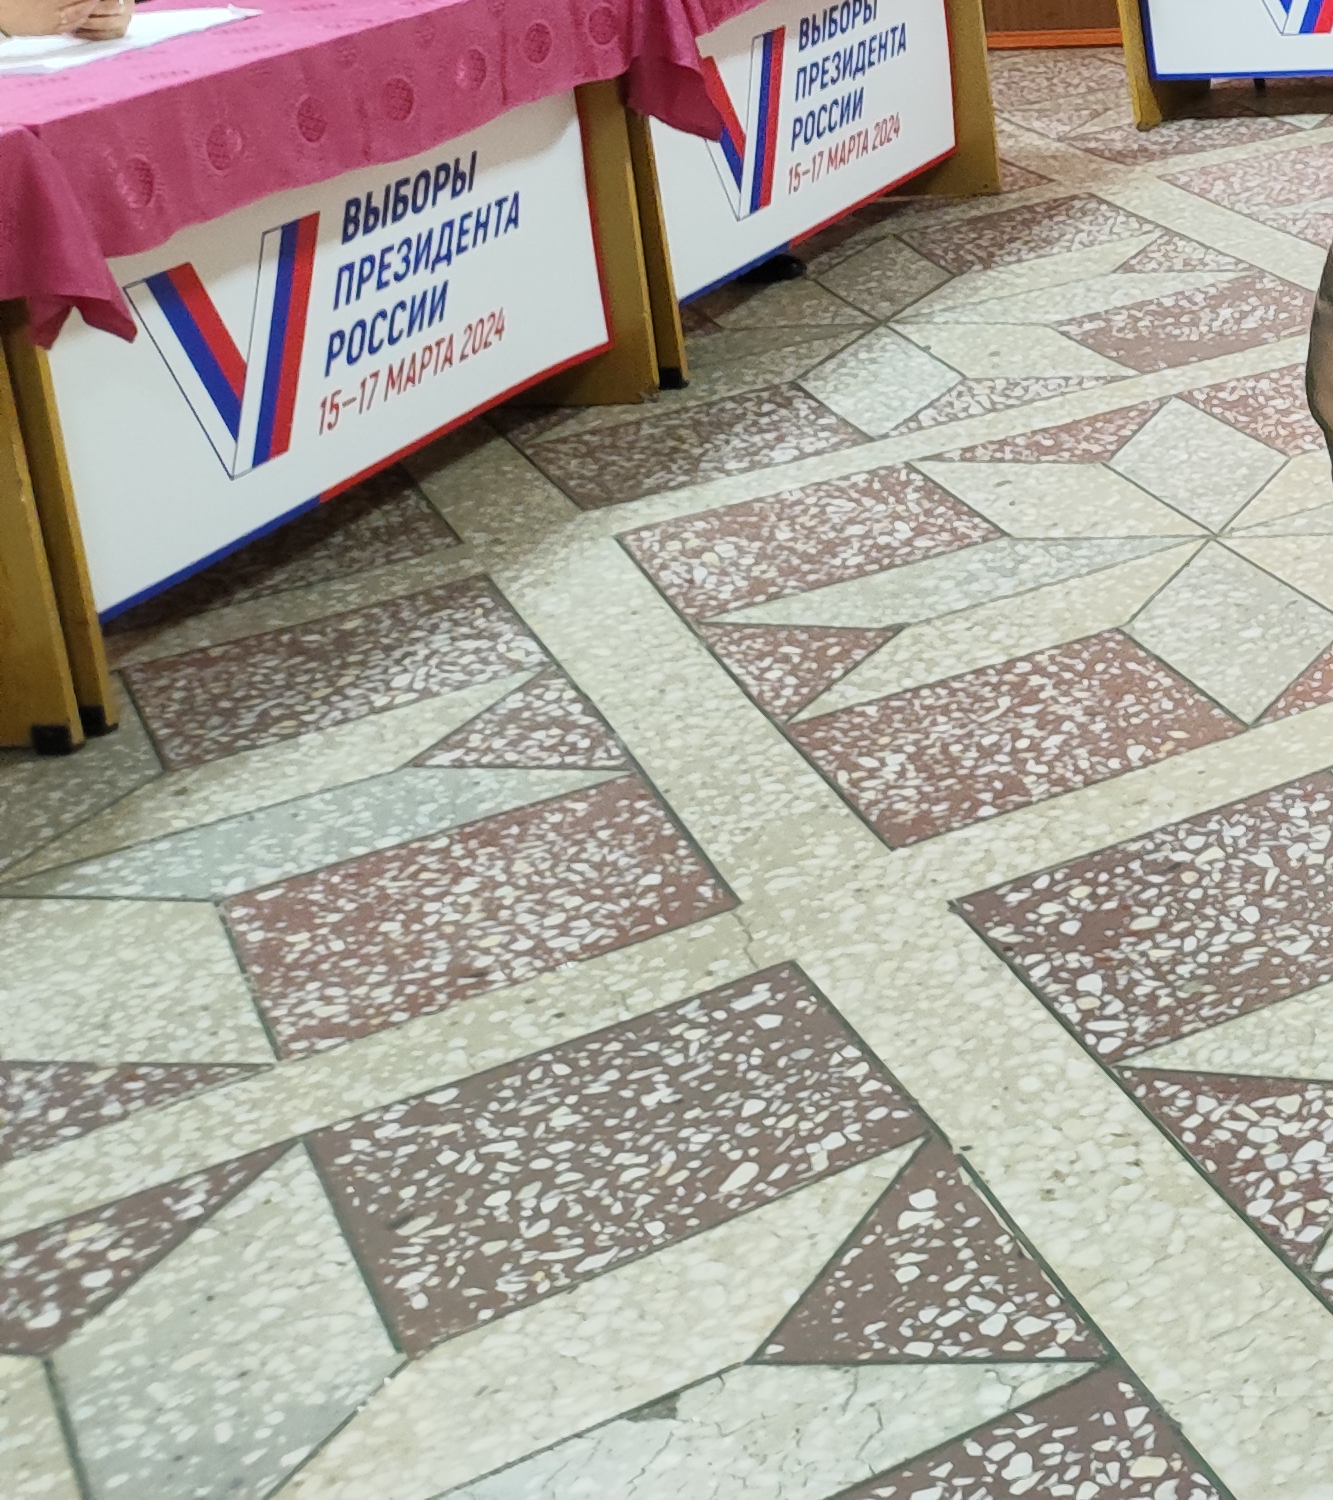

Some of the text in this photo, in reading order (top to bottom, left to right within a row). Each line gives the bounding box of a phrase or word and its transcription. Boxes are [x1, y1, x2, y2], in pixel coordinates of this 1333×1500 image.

[794, 23, 906, 103] ПРЕЗИДЕНТА
[790, 86, 864, 152] РОССИИ
[826, 126, 869, 173] МАРТА
[871, 112, 901, 152] 2024
[341, 151, 477, 245] ВЫБОРЫ
[332, 191, 520, 311] ПРЕЗИДЕНТА
[324, 281, 448, 378] РОССИИ
[384, 334, 455, 403] МАРТА
[459, 307, 505, 362] 2024
